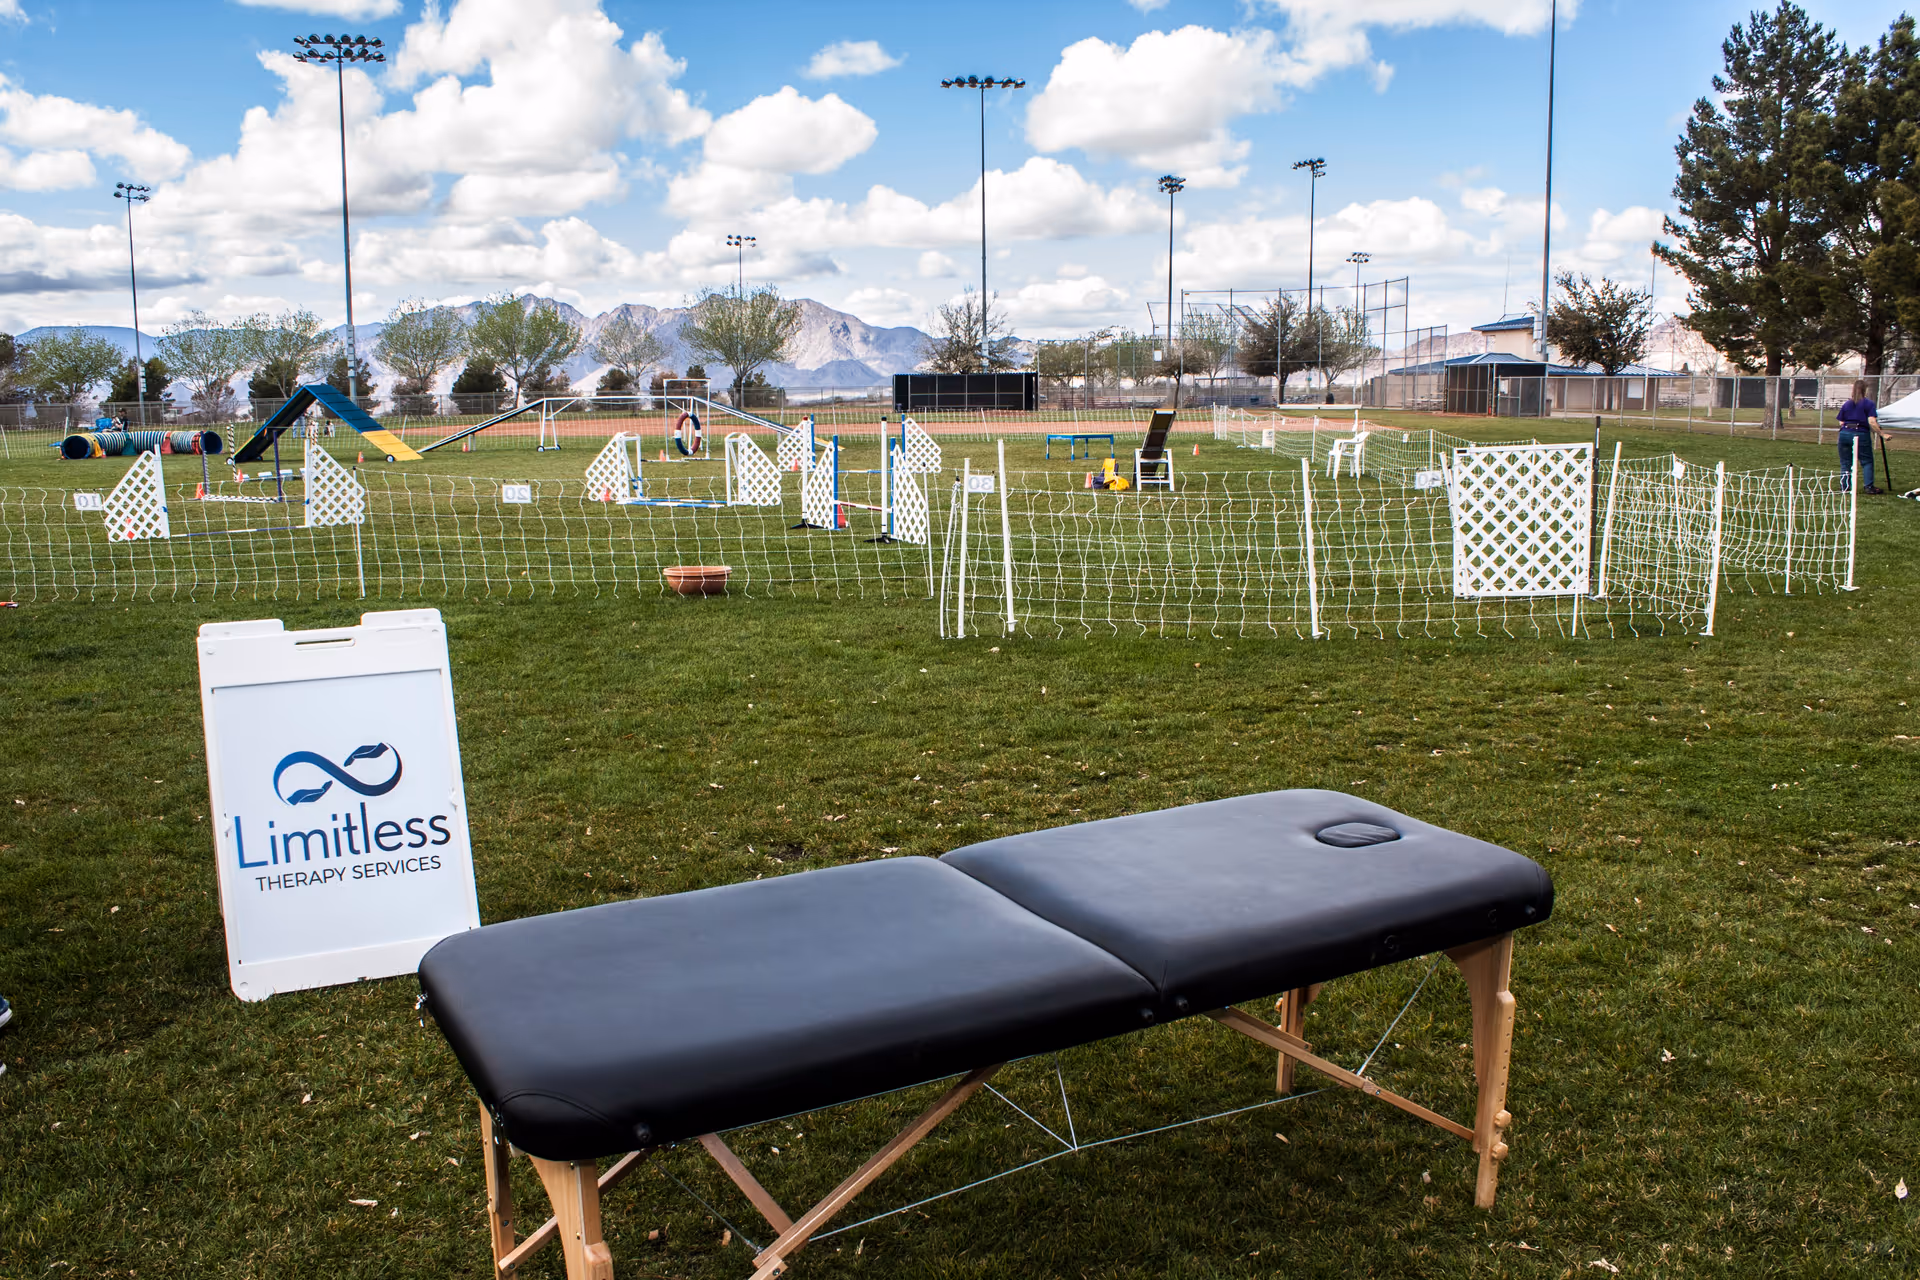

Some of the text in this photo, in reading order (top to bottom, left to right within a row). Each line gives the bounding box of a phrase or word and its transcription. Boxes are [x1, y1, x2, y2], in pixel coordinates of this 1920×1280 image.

[235, 802, 451, 869] Limitless
[256, 855, 442, 892] THERAPY SERVICES
